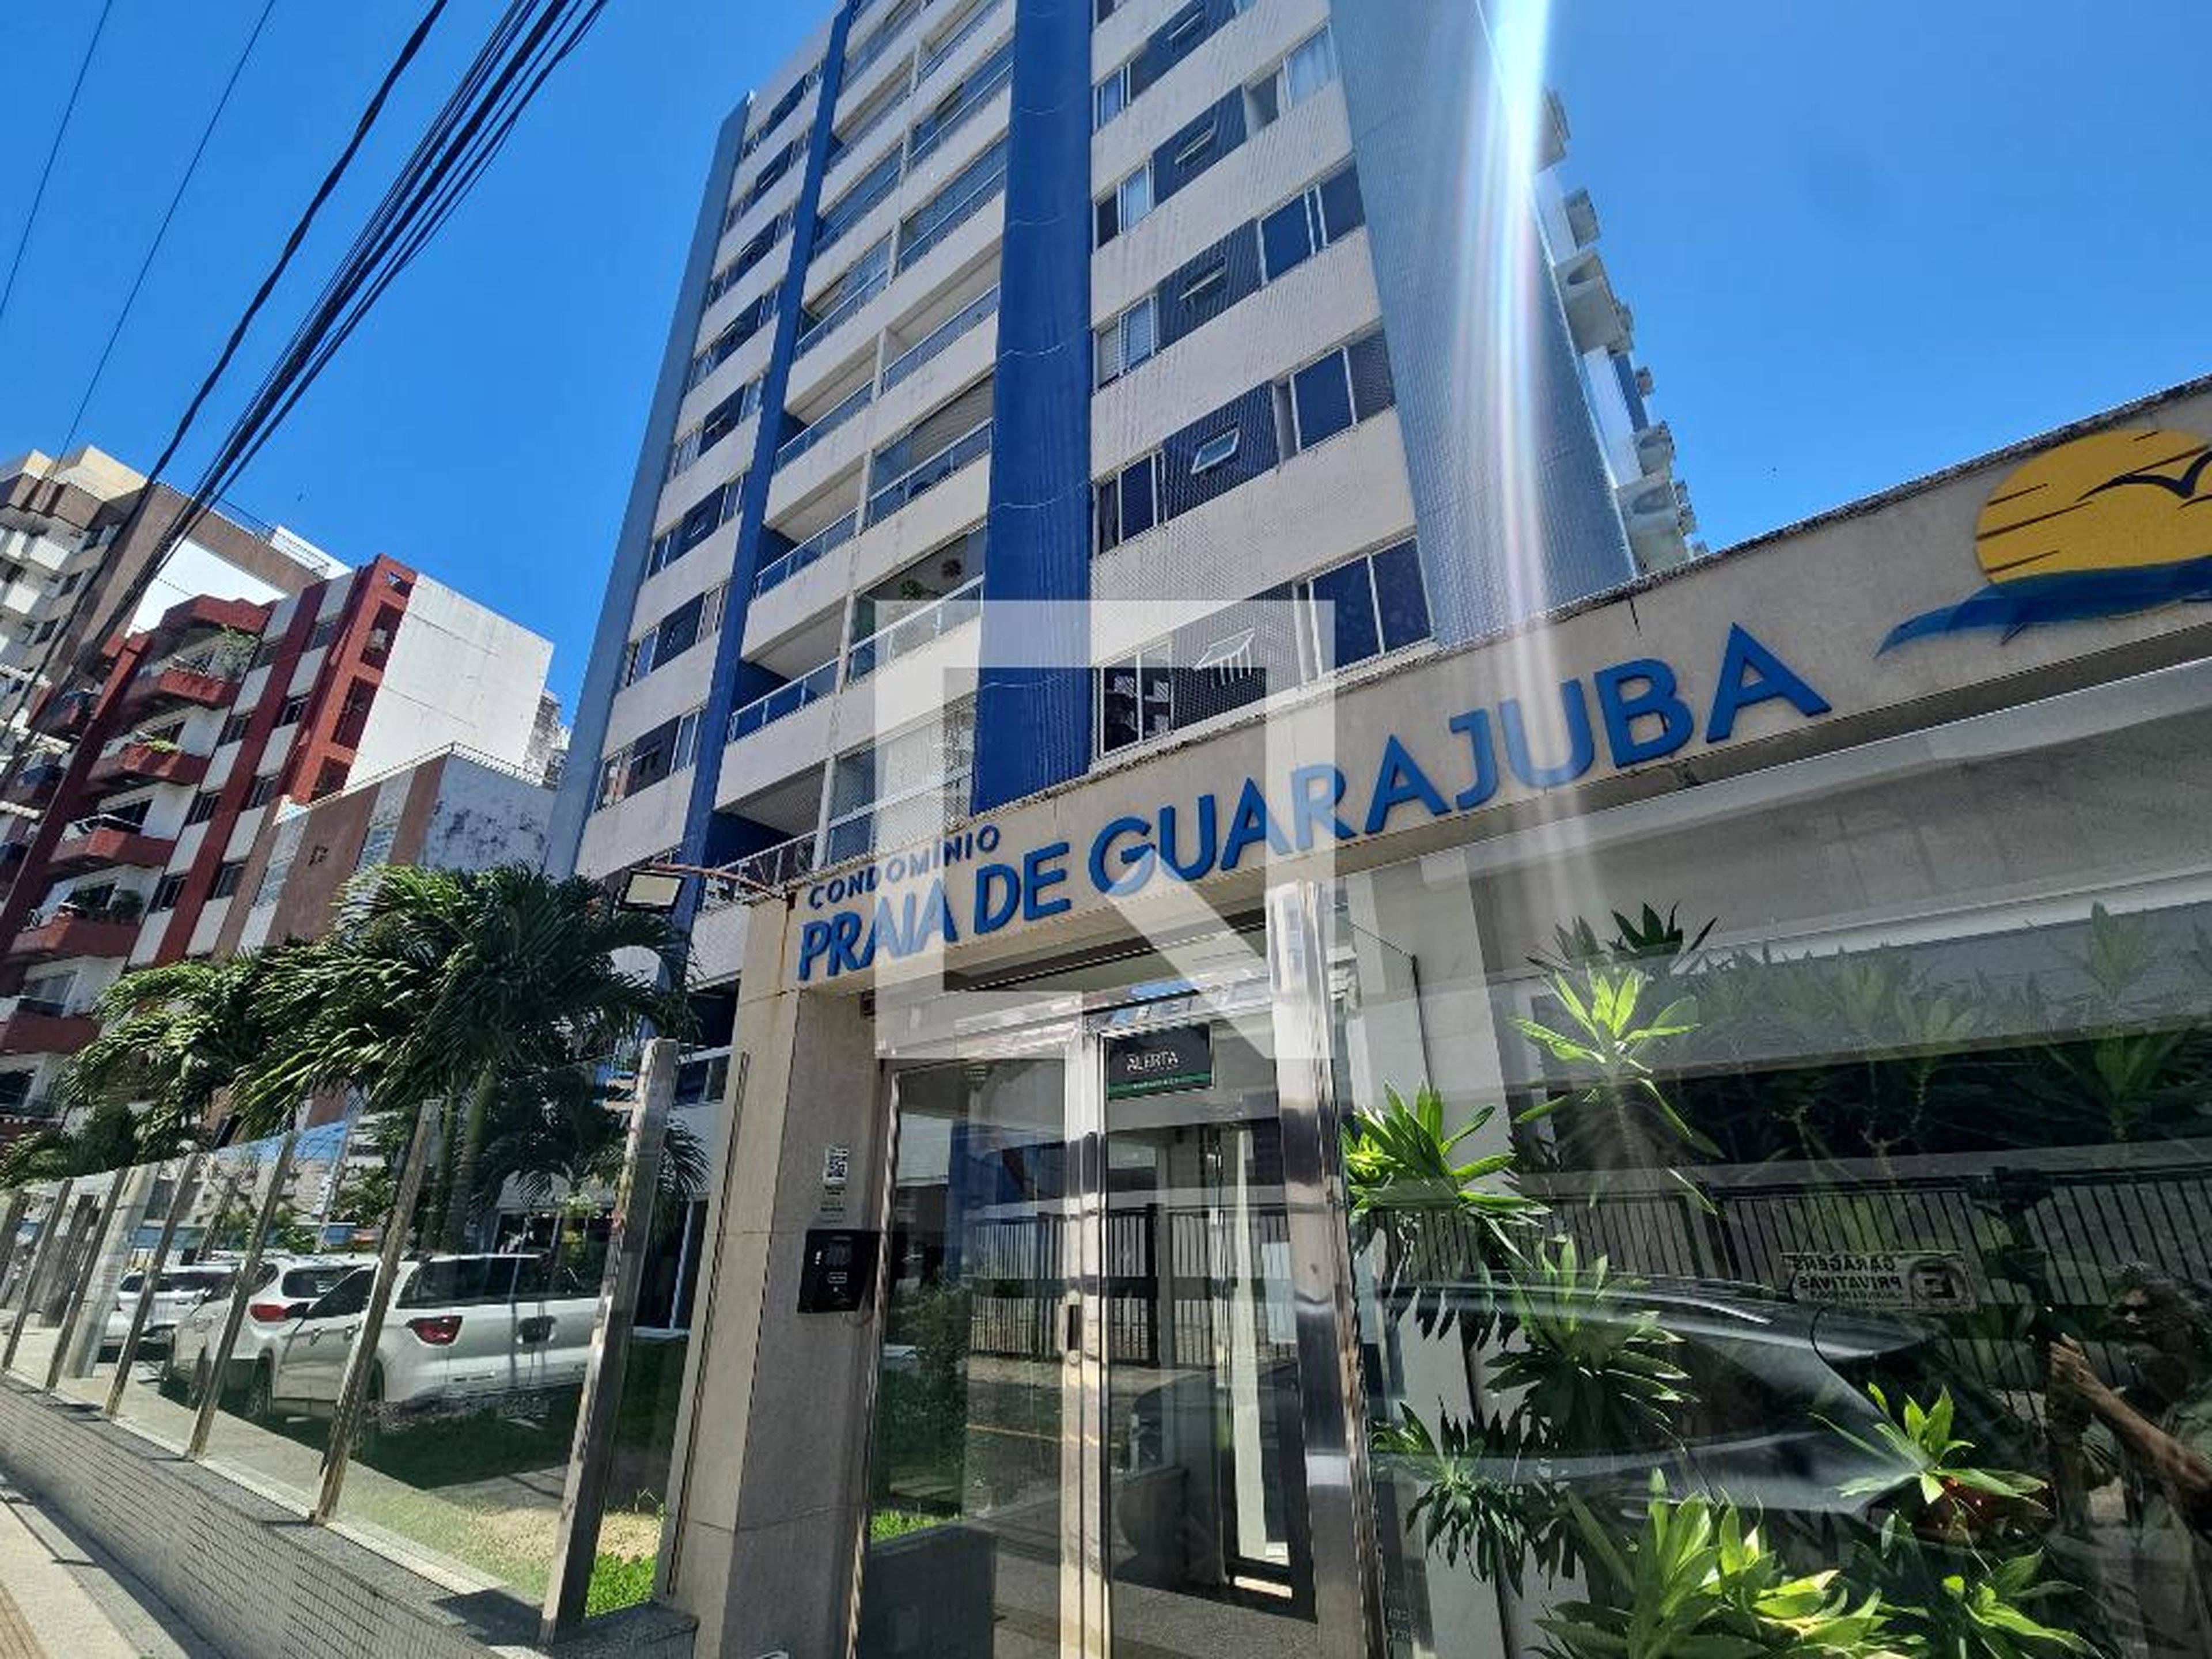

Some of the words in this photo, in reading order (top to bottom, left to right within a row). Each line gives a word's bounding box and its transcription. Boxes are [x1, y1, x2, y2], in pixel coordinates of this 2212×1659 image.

[798, 878, 959, 981] PRAIA
[974, 841, 1072, 937] DE
[1088, 622, 1833, 897] GUARAJUBA
